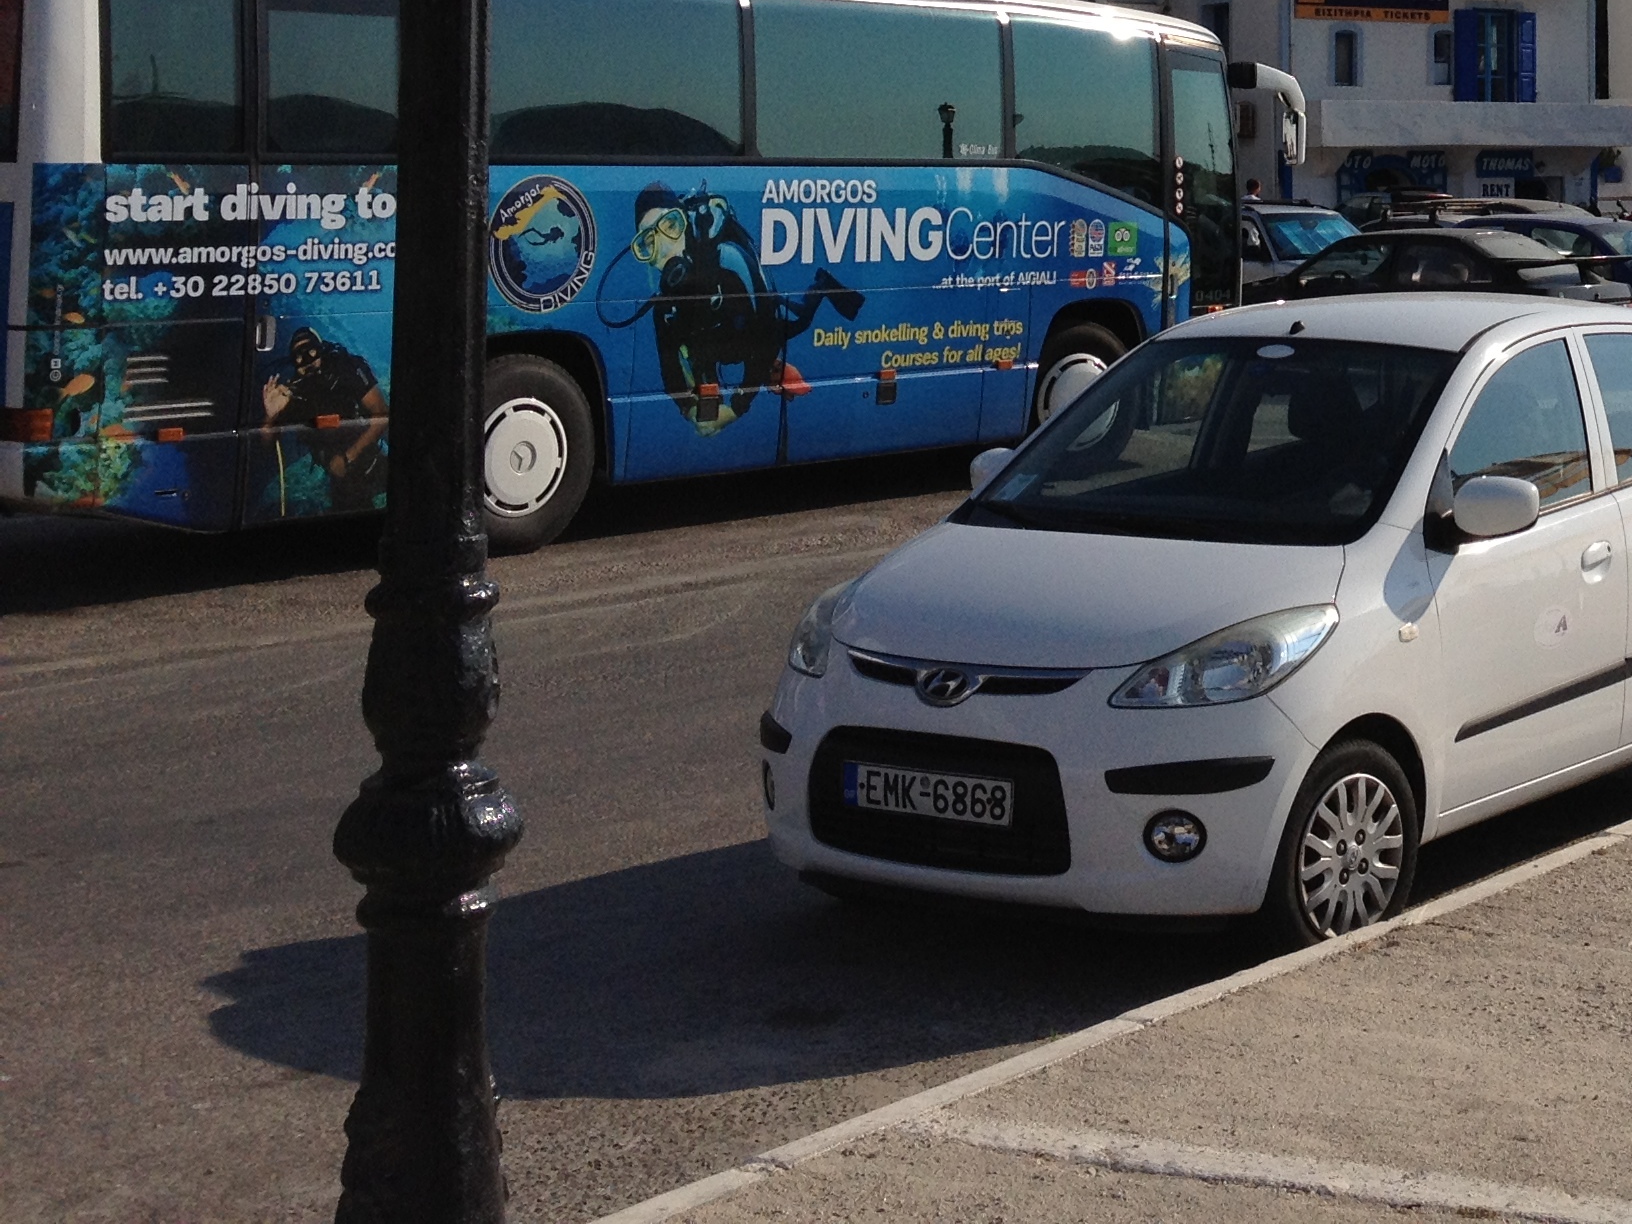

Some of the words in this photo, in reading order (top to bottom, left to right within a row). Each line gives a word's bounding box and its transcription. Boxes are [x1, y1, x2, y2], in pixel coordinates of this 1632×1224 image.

[1383, 9, 1431, 21] TICKETS
[1410, 154, 1445, 169] MOTO
[1482, 157, 1530, 171] THOMAS
[500, 183, 541, 223] Amorgos
[762, 179, 877, 204] AMORGOS
[1481, 183, 1511, 197] RENT
[105, 186, 209, 223] start
[220, 182, 347, 230] diving
[102, 276, 144, 300] tel.
[153, 275, 205, 298] +30
[211, 273, 297, 296] 22850
[304, 270, 381, 293] 73611
[540, 250, 595, 312] DIVING
[956, 273, 974, 287] the
[977, 273, 1001, 291] port
[1003, 271, 1015, 286] of
[813, 327, 851, 350] Daily
[854, 323, 929, 345] snokelling
[932, 322, 944, 339] &
[948, 320, 990, 341] diving
[993, 319, 1023, 340] trips
[881, 350, 939, 368] Courses
[943, 346, 962, 363] for
[966, 344, 982, 362] all
[984, 342, 1022, 362] ages!
[866, 770, 1007, 821] EMK-6868
